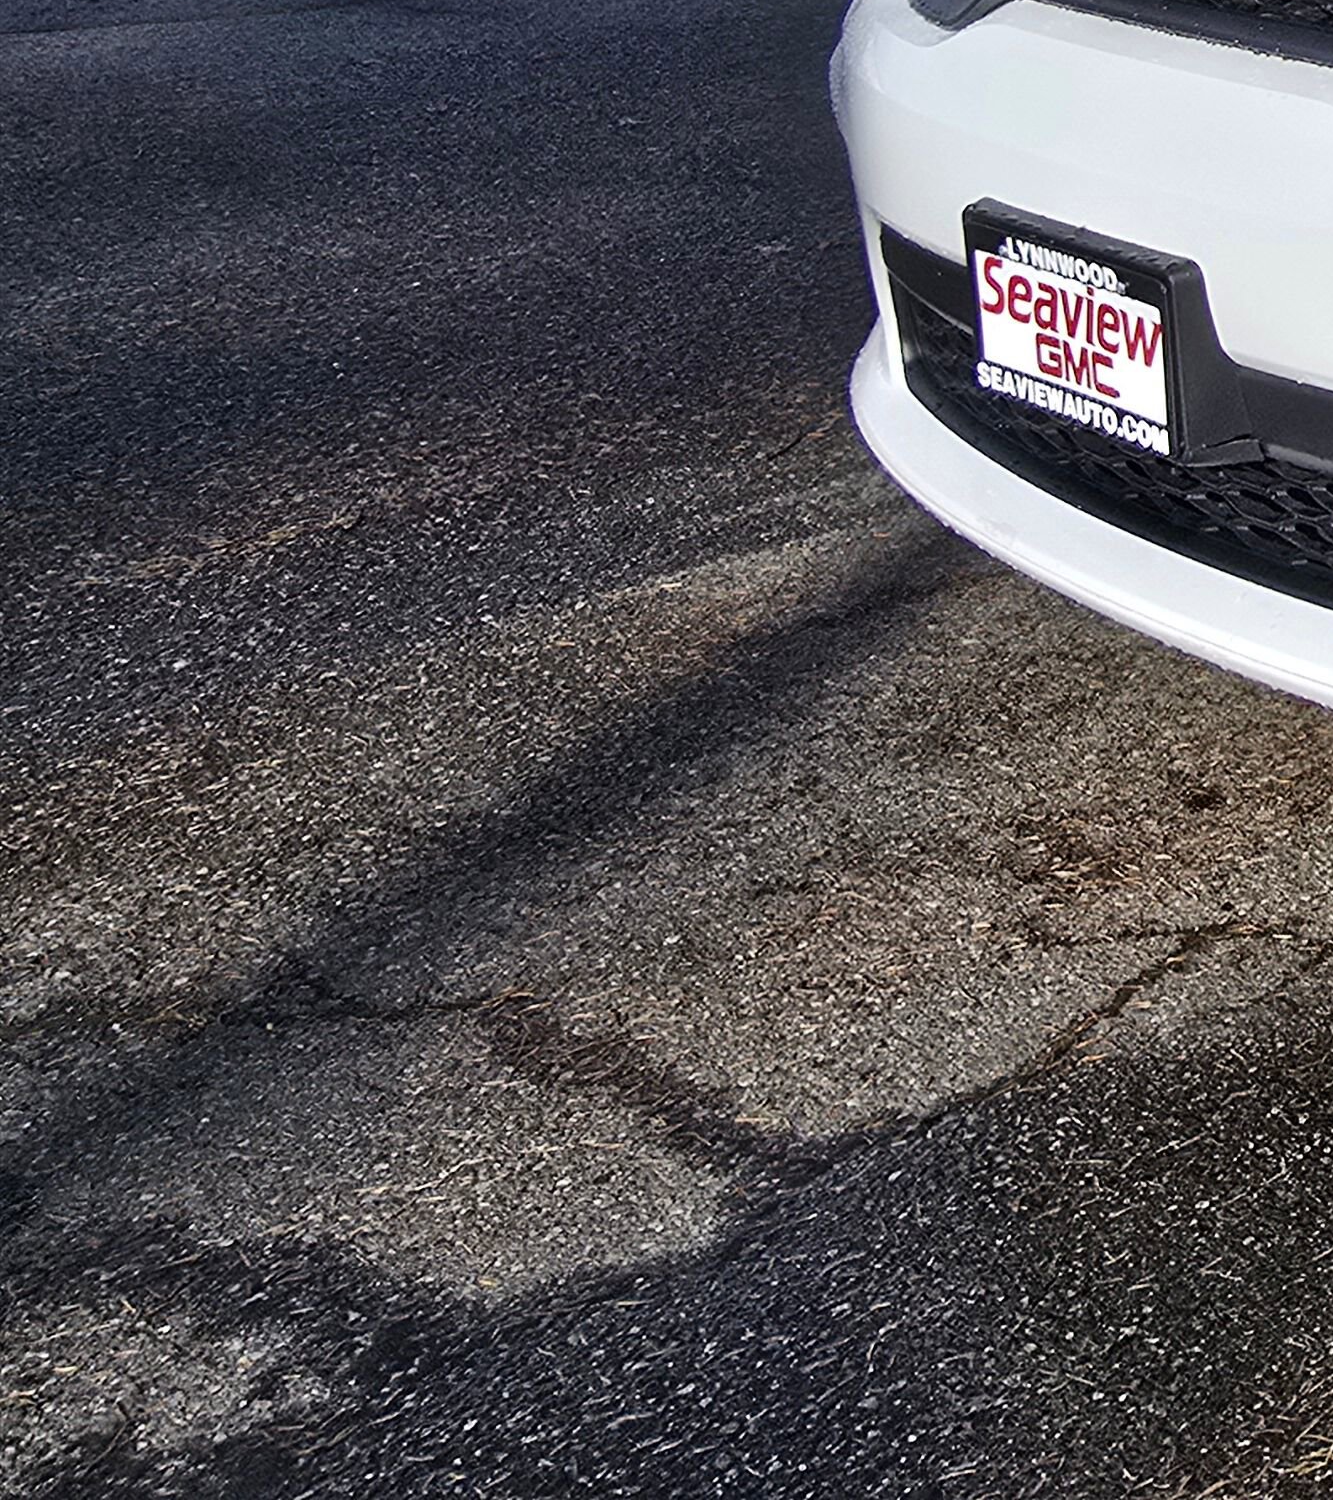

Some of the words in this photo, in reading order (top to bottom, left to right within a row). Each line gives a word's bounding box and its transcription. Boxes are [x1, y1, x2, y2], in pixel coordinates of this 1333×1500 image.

[1004, 235, 1119, 292] LYNNWOOD
[980, 256, 1164, 368] Seaview
[1035, 332, 1121, 399] GMC
[976, 360, 1170, 456] SEAVIEWAUTO.COM
